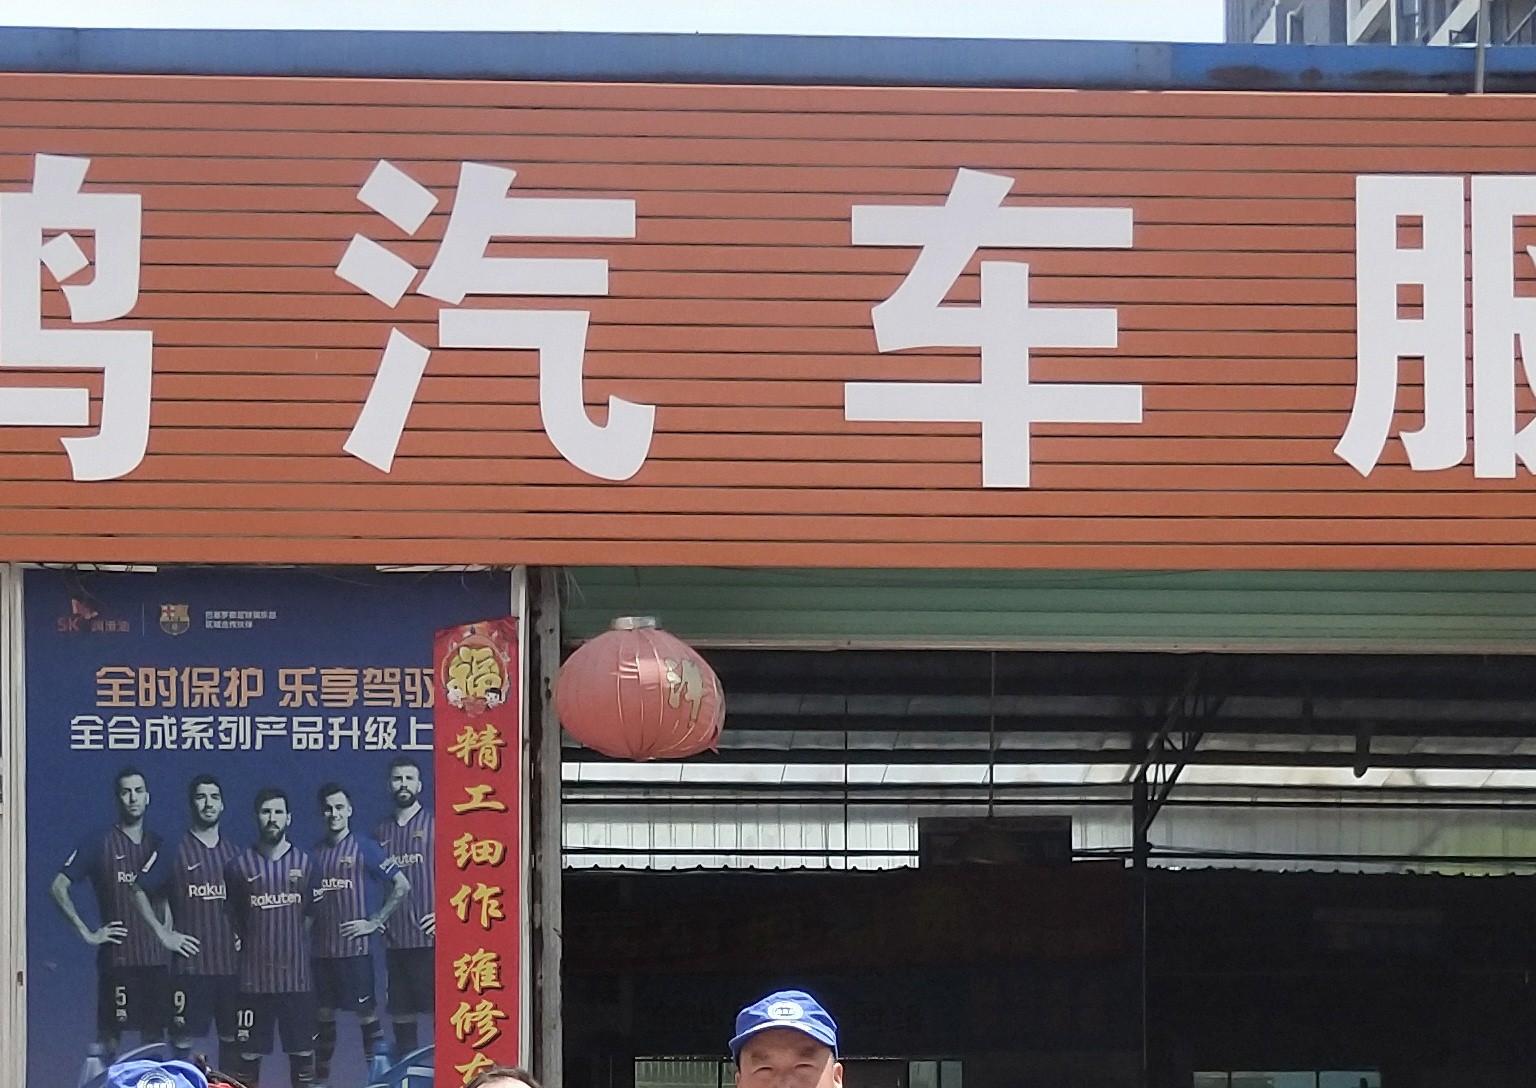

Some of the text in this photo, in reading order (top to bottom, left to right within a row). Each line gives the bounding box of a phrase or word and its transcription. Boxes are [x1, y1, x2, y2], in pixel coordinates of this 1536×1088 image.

[447, 646, 502, 698] 福
[95, 666, 264, 709] 全时保护
[69, 714, 434, 751] 全合成系列产品升级上
[250, 890, 302, 908] Rakuten
[115, 986, 127, 1006] 5
[174, 991, 186, 1014] 9
[237, 1009, 254, 1028] 10
